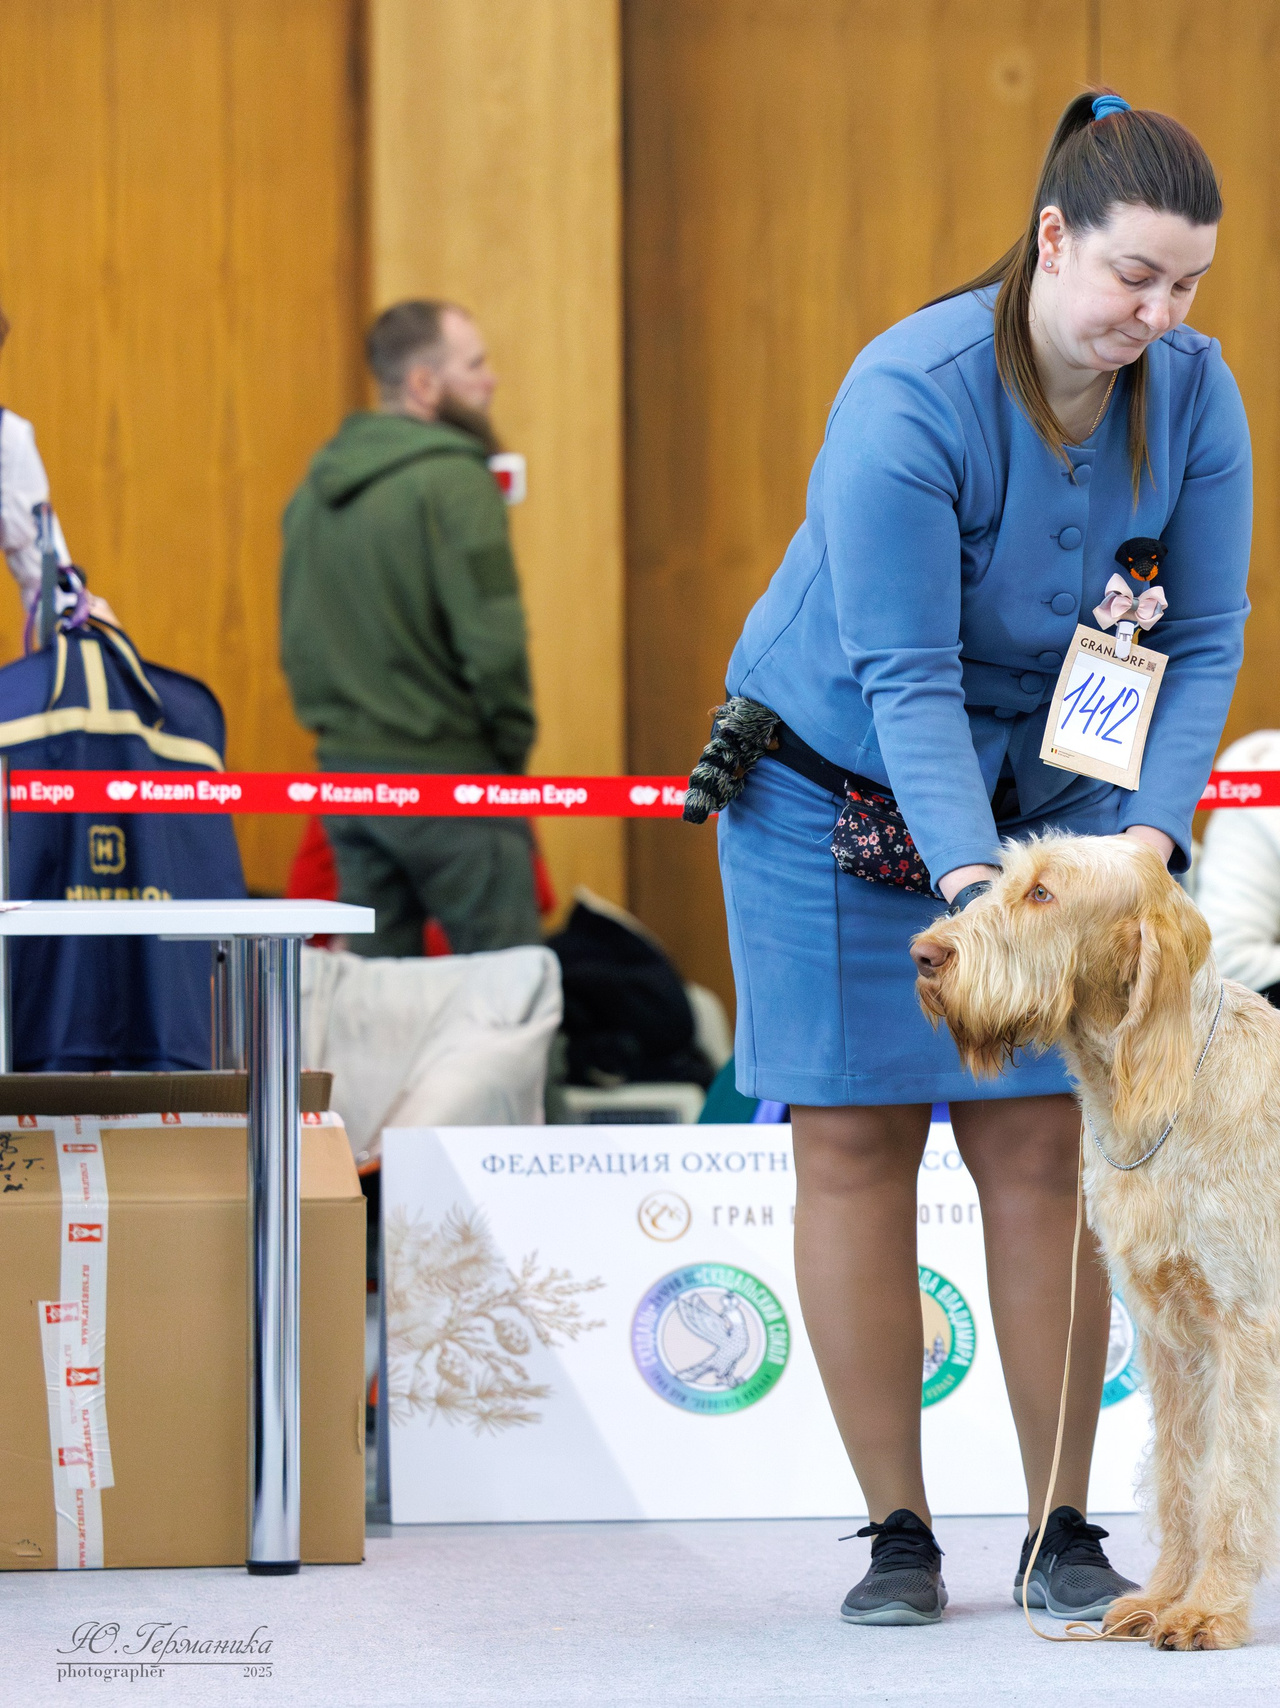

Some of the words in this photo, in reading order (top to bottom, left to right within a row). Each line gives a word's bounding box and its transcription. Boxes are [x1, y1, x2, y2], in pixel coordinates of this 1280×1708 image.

[1061, 672, 1140, 744] 1412
[30, 781, 75, 804] Expo
[140, 781, 195, 801] Kazan
[197, 781, 242, 804] Expo
[320, 783, 374, 803] Kazan
[375, 783, 420, 807] Expo
[487, 785, 541, 804] Kazan
[542, 785, 588, 808] Expo
[1218, 779, 1262, 803] Expo
[482, 1153, 671, 1177] ФЕДЕРАЦИЯ
[681, 1152, 789, 1173] ОХОТН
[922, 1150, 964, 1171] СО
[712, 1205, 774, 1227] ГРАН
[919, 1203, 978, 1225] ОТОГ
